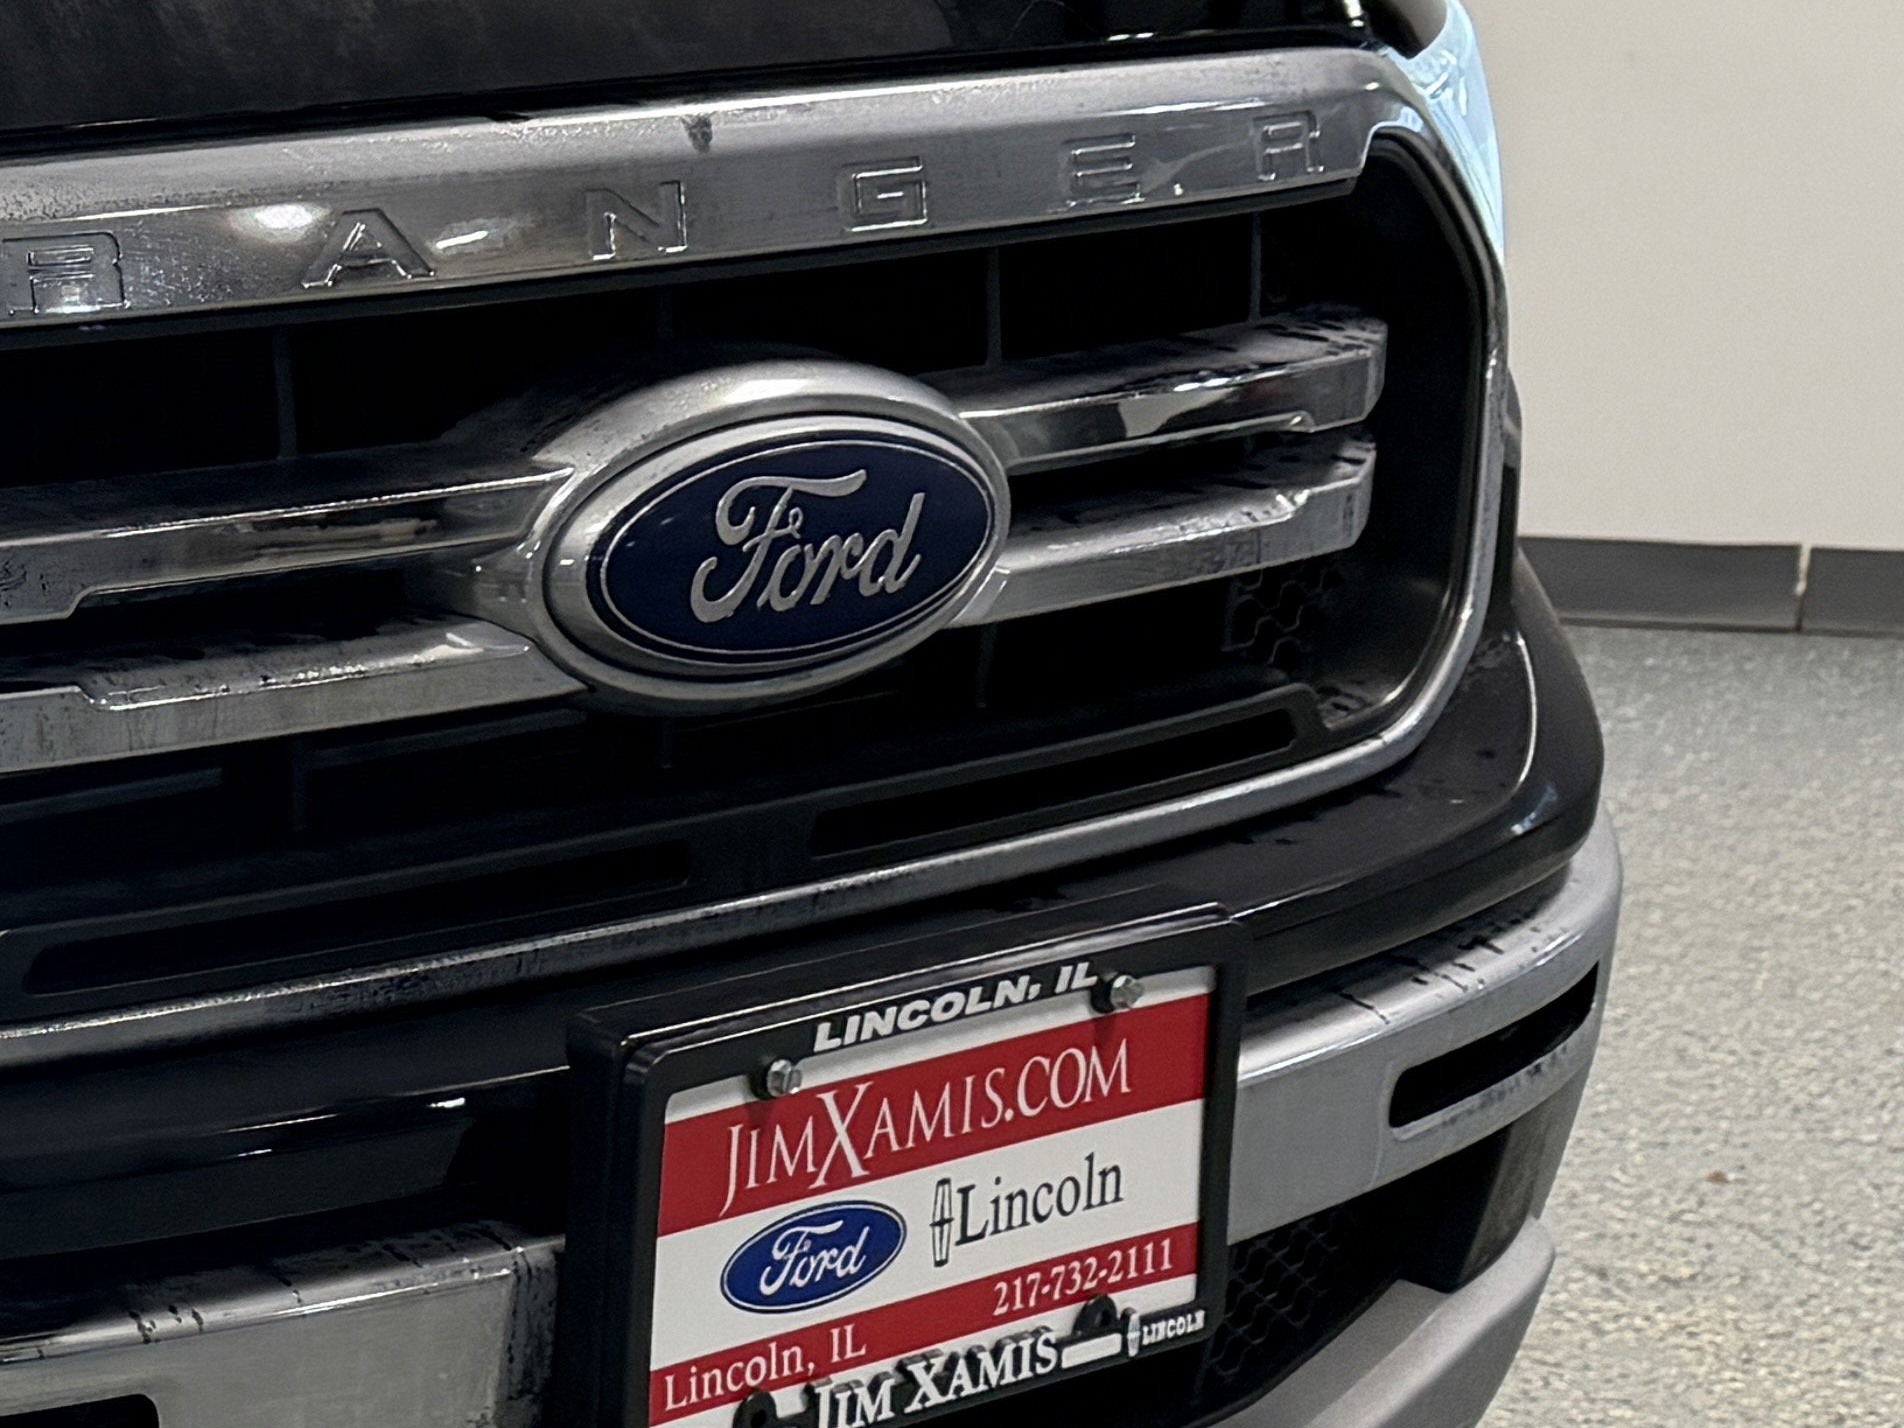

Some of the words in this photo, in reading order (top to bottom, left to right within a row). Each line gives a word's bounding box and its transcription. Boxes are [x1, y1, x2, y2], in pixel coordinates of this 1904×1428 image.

[4, 109, 1323, 315] RANGER
[691, 469, 925, 623] Ford
[813, 974, 1041, 1052] LINCOLN,
[1054, 962, 1098, 994] IL
[719, 1038, 1132, 1217] JIMXAMIS.COM
[955, 1152, 1124, 1246] Lincoln
[759, 1219, 870, 1297] Ford
[992, 1237, 1173, 1317] 217-732-2111
[664, 1339, 815, 1413] Lincoln,
[830, 1324, 867, 1363] IL
[1142, 1309, 1205, 1345] LINCOLN
[904, 1332, 1058, 1414] XAMIS
